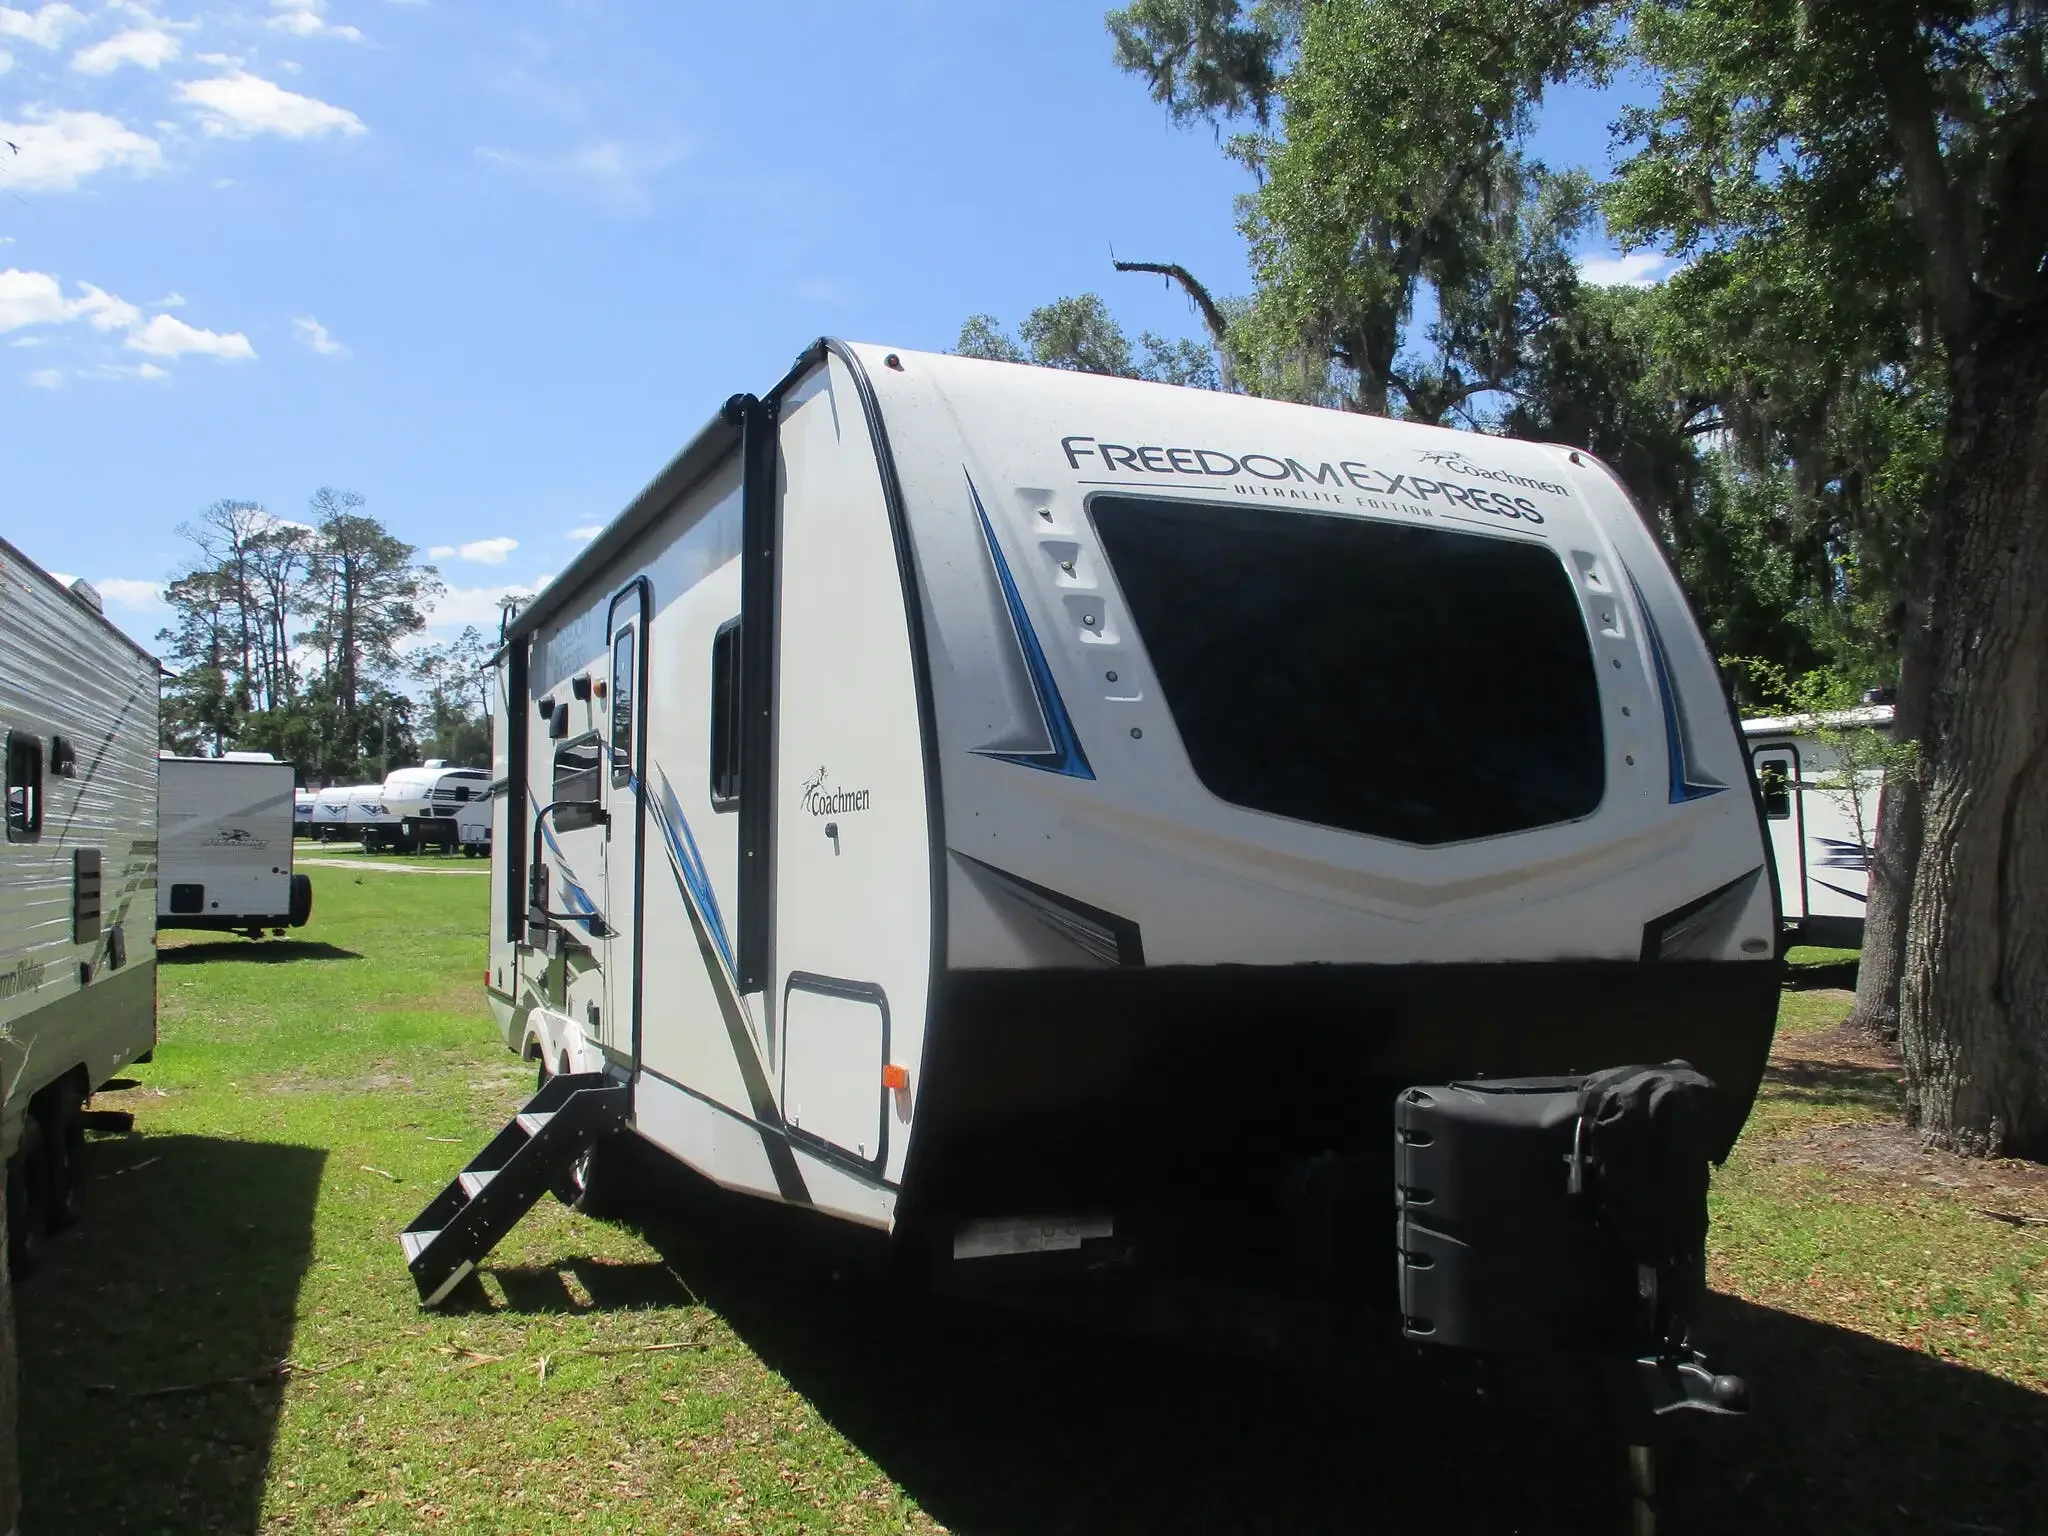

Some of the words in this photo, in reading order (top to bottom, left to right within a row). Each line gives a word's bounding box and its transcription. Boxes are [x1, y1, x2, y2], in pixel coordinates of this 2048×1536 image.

[1445, 460, 1571, 498] Coachmen
[1234, 484, 1345, 505] ULTRALITE
[1356, 497, 1434, 518] EDITION
[811, 786, 870, 817] Coachmen
